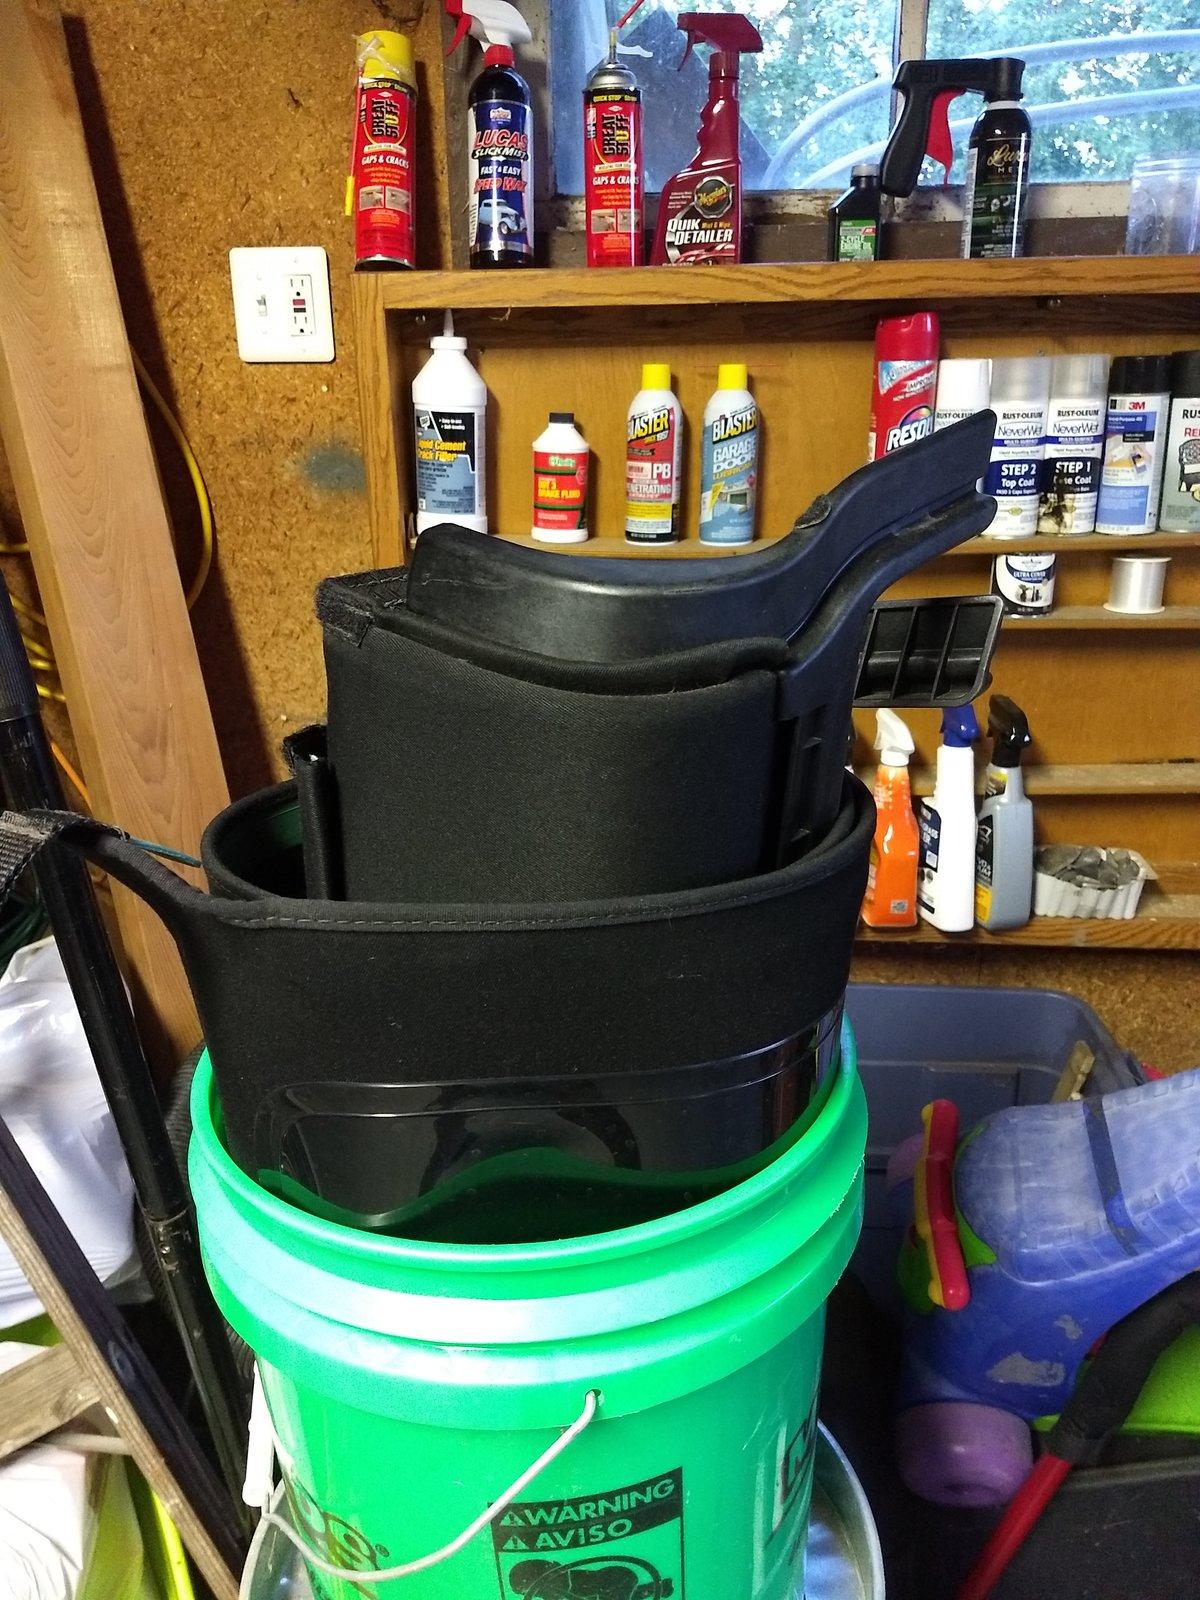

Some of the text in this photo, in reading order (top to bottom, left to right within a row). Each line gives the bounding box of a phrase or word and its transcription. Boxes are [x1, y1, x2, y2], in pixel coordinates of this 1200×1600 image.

[371, 98, 386, 136] GREAT
[385, 99, 400, 138] STUFF
[474, 129, 528, 151] LUCAS
[602, 113, 616, 154] GREAT
[616, 113, 630, 155] STUFF
[361, 154, 409, 169] GAPS & CRACKS
[480, 166, 498, 175] FAST
[502, 166, 521, 175] EASY
[474, 178, 502, 194] SPEED
[592, 176, 608, 185] GAPS
[609, 176, 616, 185] &
[667, 218, 701, 232] QUIK
[674, 229, 733, 246] DETAILER
[1128, 401, 1146, 410] 3M
[1057, 409, 1099, 417] RUST-OLEUM
[998, 425, 1043, 437] NeverWet
[1053, 422, 1099, 434] NeverWet
[435, 441, 467, 452] Cement
[435, 451, 458, 463] Filler
[653, 463, 671, 479] PB
[1001, 464, 1037, 476] STEP 2
[1055, 461, 1091, 474] STEP 1
[1001, 478, 1036, 490] Top Coat
[1074, 475, 1092, 485] Coat
[524, 1478, 676, 1526] WARNING
[535, 1518, 633, 1550] AVISO
